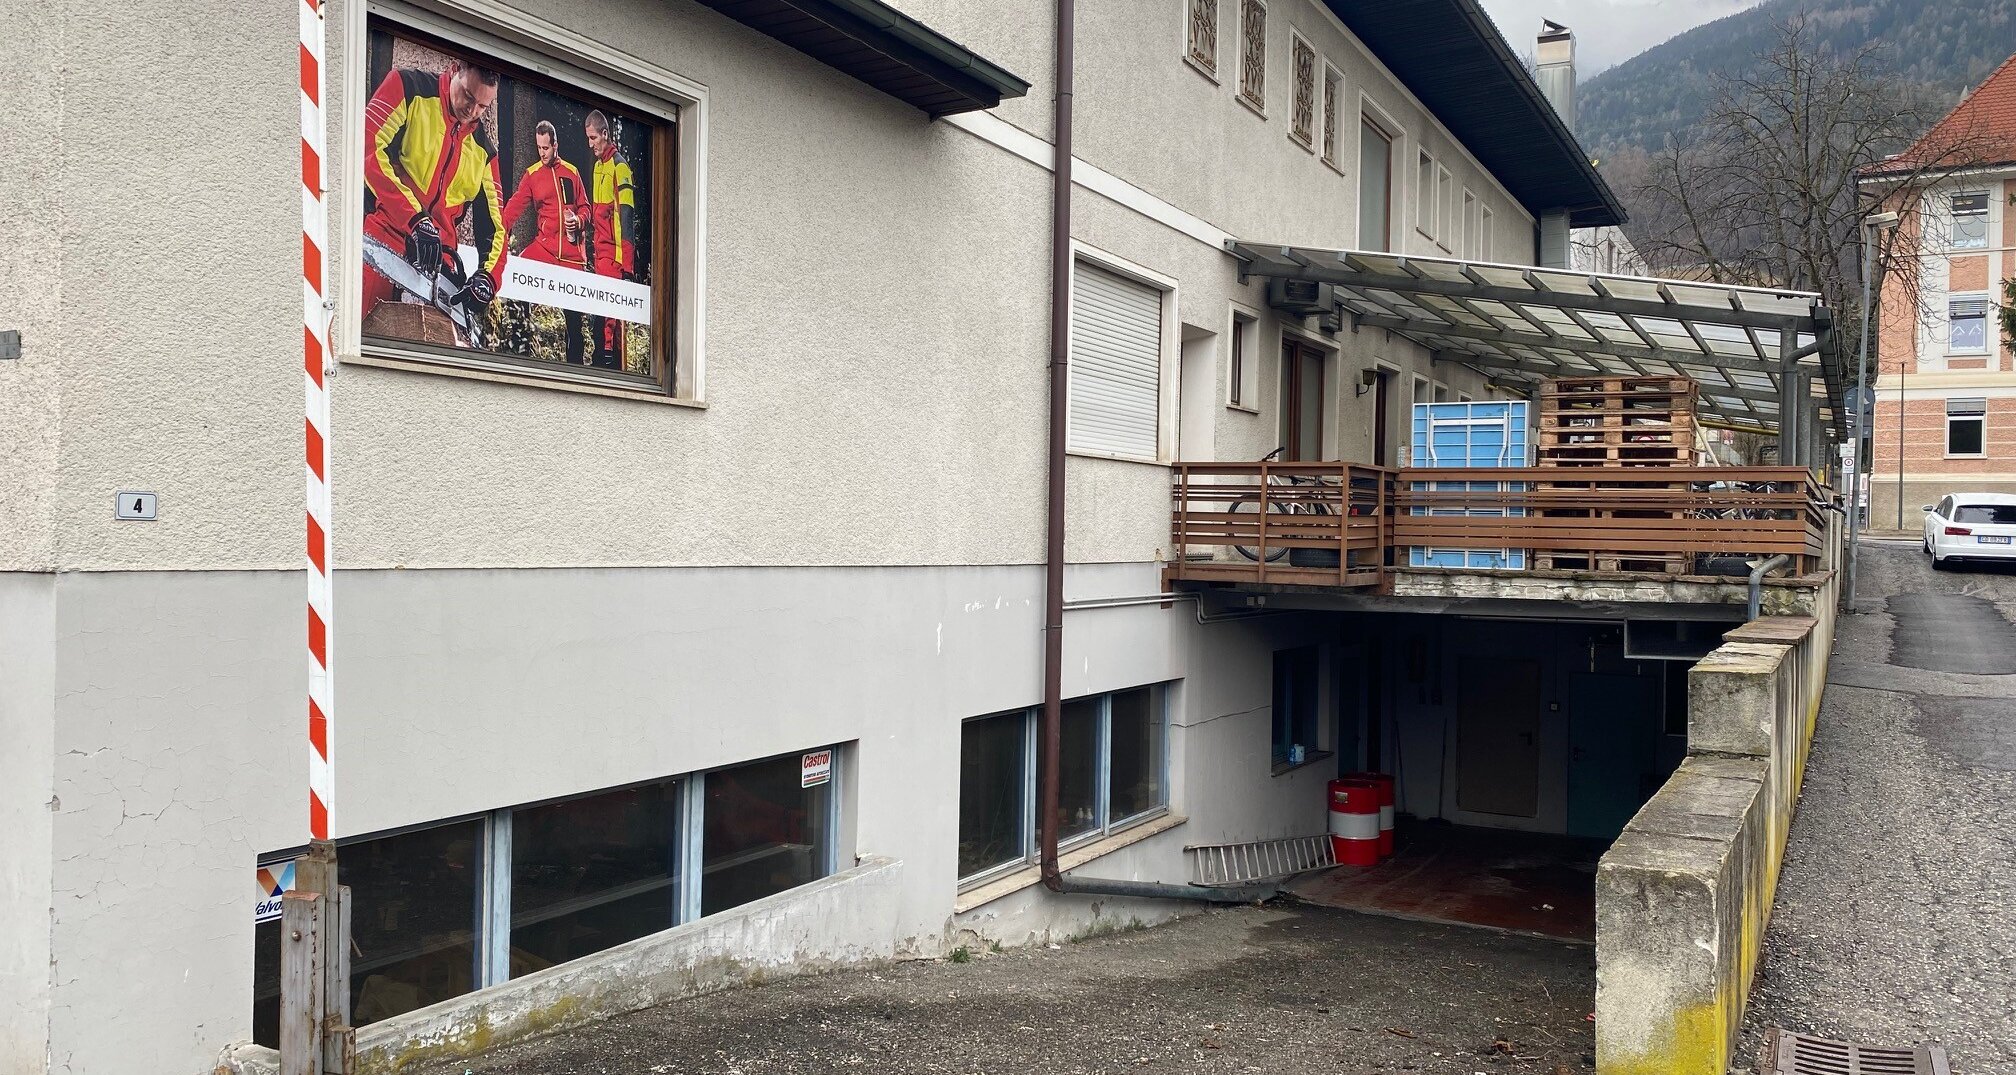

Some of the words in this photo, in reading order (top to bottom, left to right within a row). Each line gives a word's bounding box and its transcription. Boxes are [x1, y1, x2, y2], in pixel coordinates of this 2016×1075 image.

[512, 272, 545, 289] FORST
[548, 279, 556, 292] &
[558, 281, 644, 309] HOLZWIRTSCHAFT
[132, 498, 143, 514] 4
[804, 751, 830, 769] Castrol
[255, 900, 282, 915] alvo
